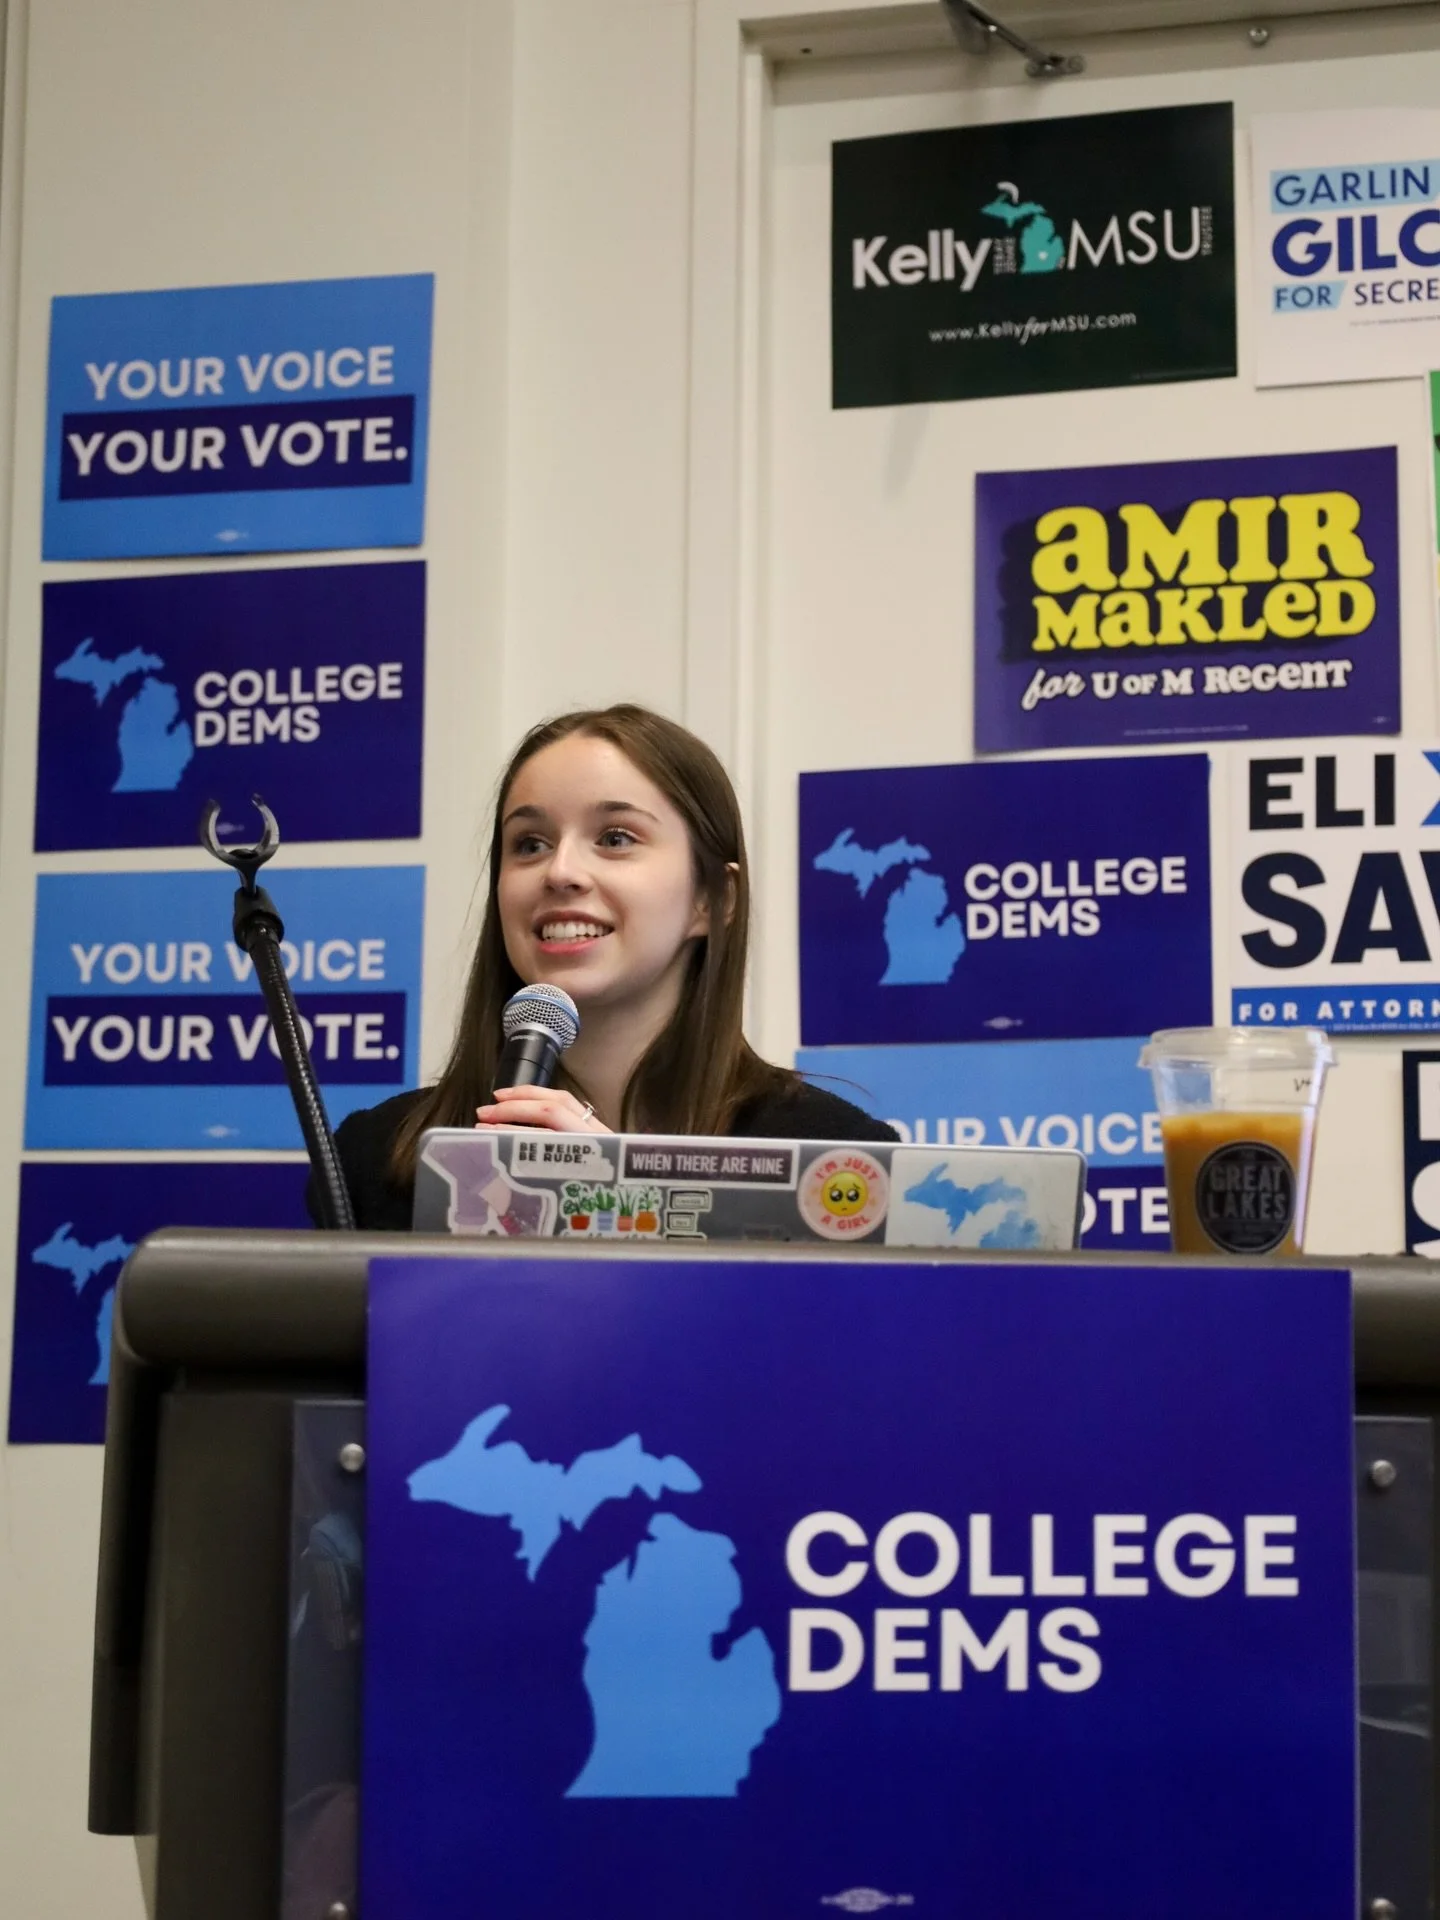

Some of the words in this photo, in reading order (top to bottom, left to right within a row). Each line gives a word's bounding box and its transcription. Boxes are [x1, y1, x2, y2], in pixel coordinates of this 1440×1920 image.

[1275, 166, 1429, 206] GARLIN
[852, 229, 993, 292] Kelly
[1067, 207, 1201, 270] MSU
[1276, 285, 1332, 309] FOR
[929, 312, 1137, 346] www.KellyforMSU.com
[85, 357, 225, 401] YOUR
[238, 346, 394, 394] VOICE
[68, 426, 226, 477] YOUR
[240, 417, 408, 468] VOTE.
[194, 663, 403, 708] COLLEGE
[1021, 667, 1086, 711] for
[1091, 671, 1119, 699] U
[1122, 674, 1158, 695] OF
[1161, 668, 1194, 696] M
[194, 705, 320, 747] DEMS
[1249, 754, 1396, 831] ELI
[964, 856, 1187, 900] COLLEGE
[966, 899, 1101, 940] DEMS
[71, 943, 212, 984] YOUR
[1238, 1002, 1299, 1022] FOR
[52, 1015, 214, 1062] YOUR
[519, 1142, 538, 1152] BE
[543, 1143, 596, 1155] WEIRD.
[519, 1151, 538, 1162] BE
[543, 1151, 587, 1164] RUDE.
[632, 1152, 672, 1170] WHEN
[675, 1154, 718, 1173] THERE
[720, 1156, 749, 1174] ARE
[751, 1156, 785, 1175] NINE
[815, 1161, 838, 1180] I'M
[844, 1157, 879, 1180] JUST
[1209, 1165, 1284, 1192] GREAT
[821, 1214, 832, 1225] A
[837, 1214, 871, 1230] GIRL
[1207, 1190, 1287, 1219] LAKES
[785, 1510, 1299, 1598] COLLEGE
[788, 1606, 1102, 1693] DEMS
